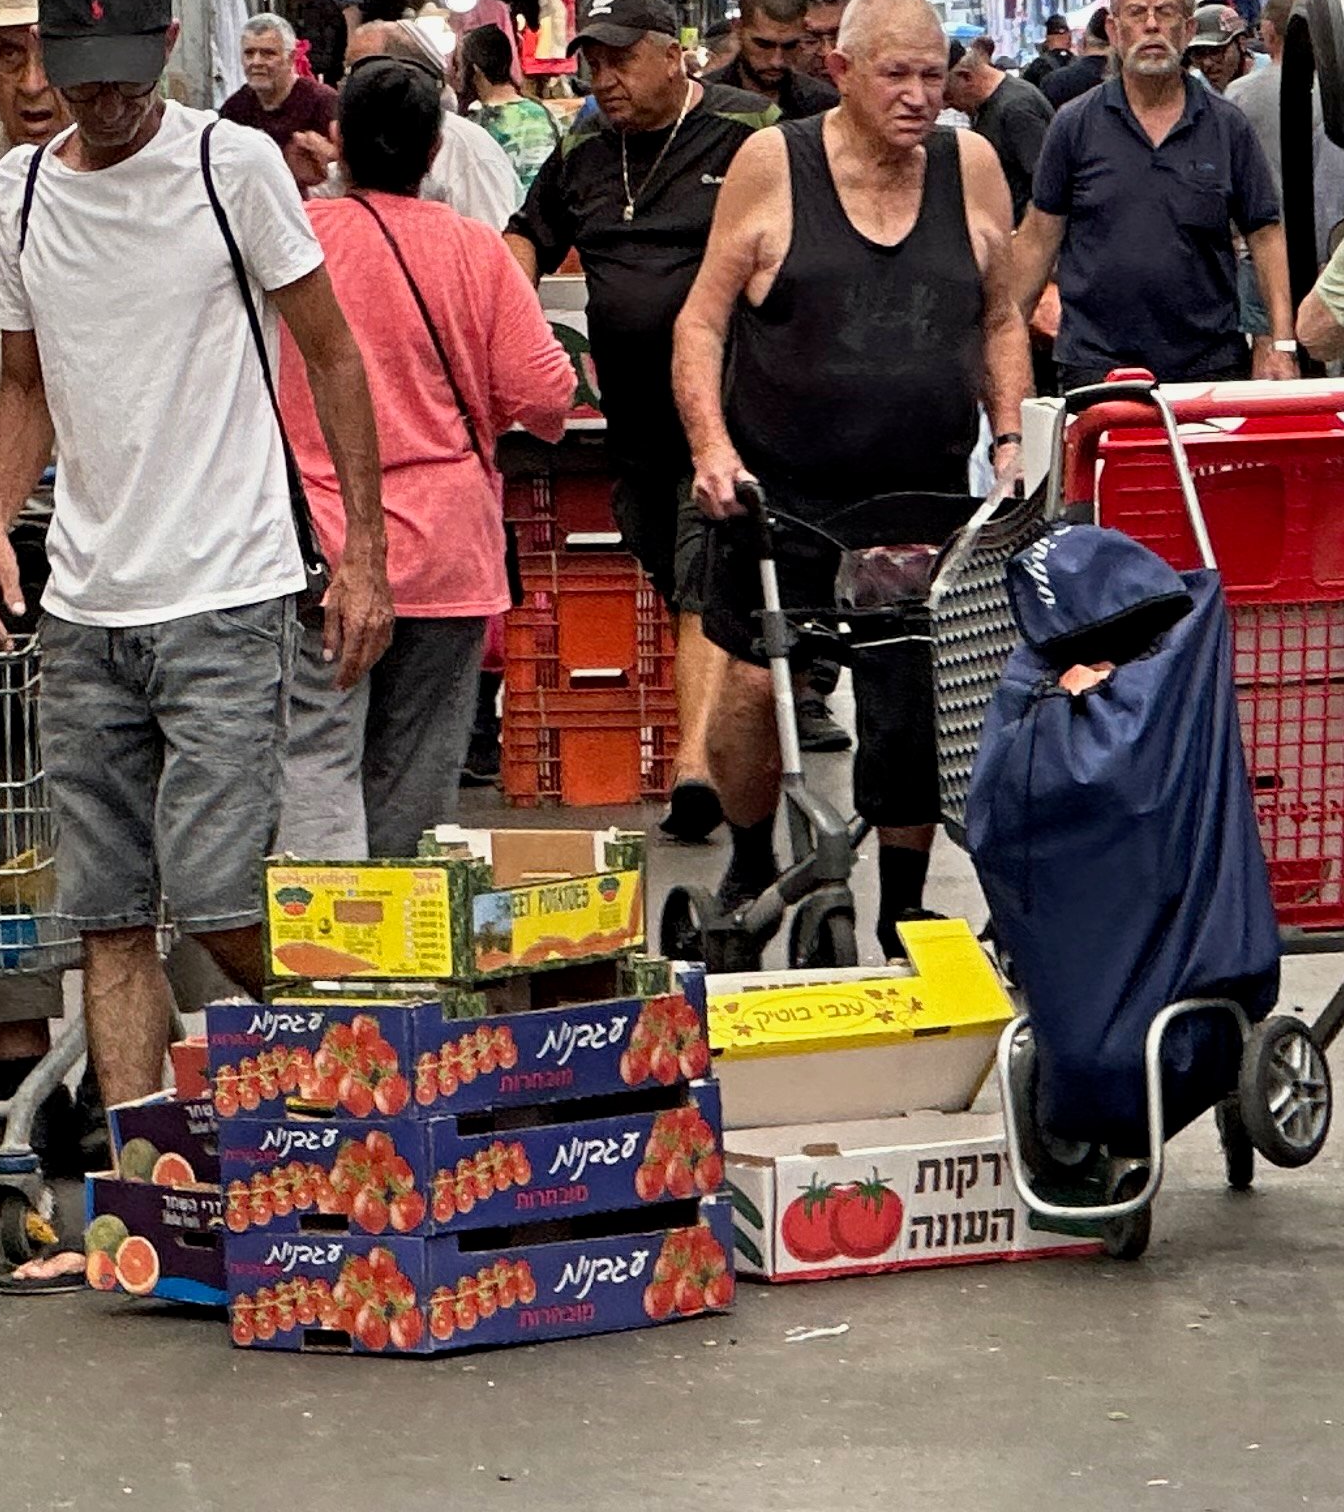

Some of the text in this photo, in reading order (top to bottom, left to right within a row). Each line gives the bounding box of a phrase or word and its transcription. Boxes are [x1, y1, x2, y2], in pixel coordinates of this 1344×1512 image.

[753, 999, 866, 1031] ענבי בוטיק
[514, 1184, 590, 1210] מובחרות
[908, 1207, 1015, 1250] העונה
